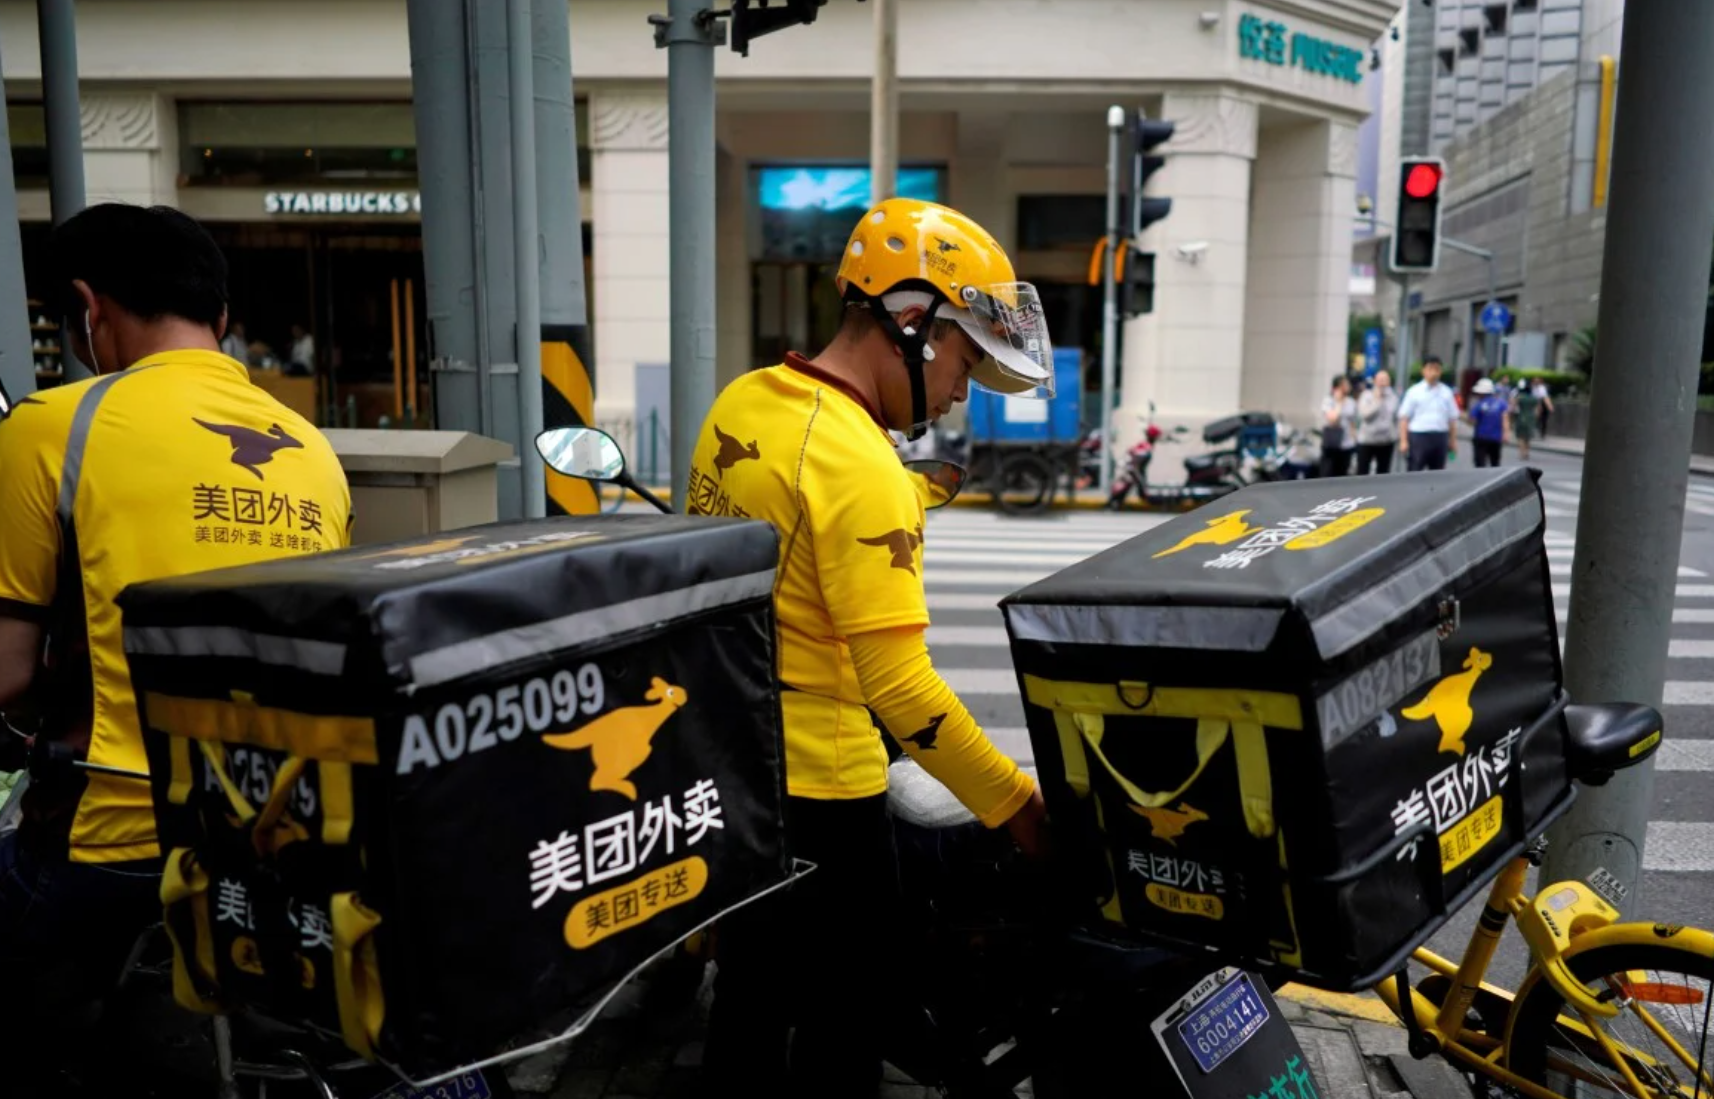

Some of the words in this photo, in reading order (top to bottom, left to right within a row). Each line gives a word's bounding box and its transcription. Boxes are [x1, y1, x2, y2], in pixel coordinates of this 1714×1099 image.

[265, 191, 409, 213] STARBUCKS
[193, 483, 322, 536] 美团外卖
[195, 526, 262, 545] 美团外卖
[1203, 496, 1377, 569] 美团外卖
[396, 662, 605, 775] A025099
[528, 778, 725, 909] 美团外卖
[1441, 804, 1497, 866] 美团专送
[584, 866, 690, 937] 美团专送
[1190, 1013, 1211, 1036] 上海
[1197, 995, 1258, 1054] 6004141
